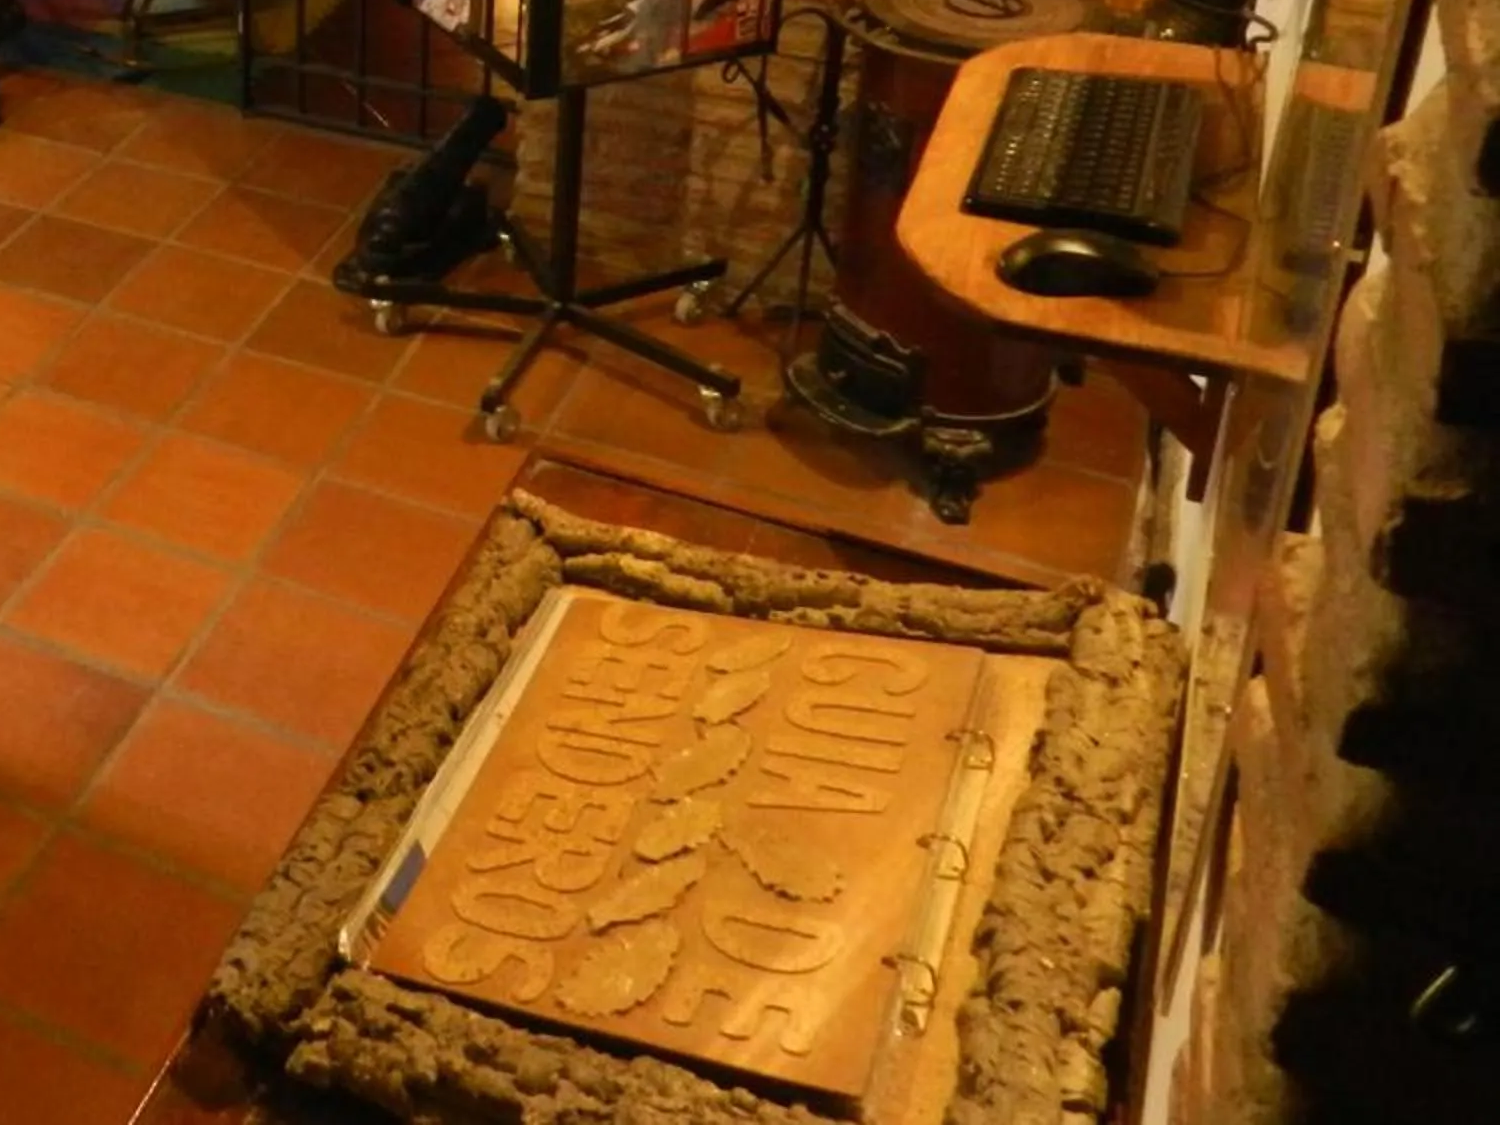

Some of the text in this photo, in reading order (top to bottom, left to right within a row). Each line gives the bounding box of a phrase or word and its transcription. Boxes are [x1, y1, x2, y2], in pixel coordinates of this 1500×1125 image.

[423, 601, 712, 1004] SENDEROS
[662, 641, 930, 1058] GUIA DE
